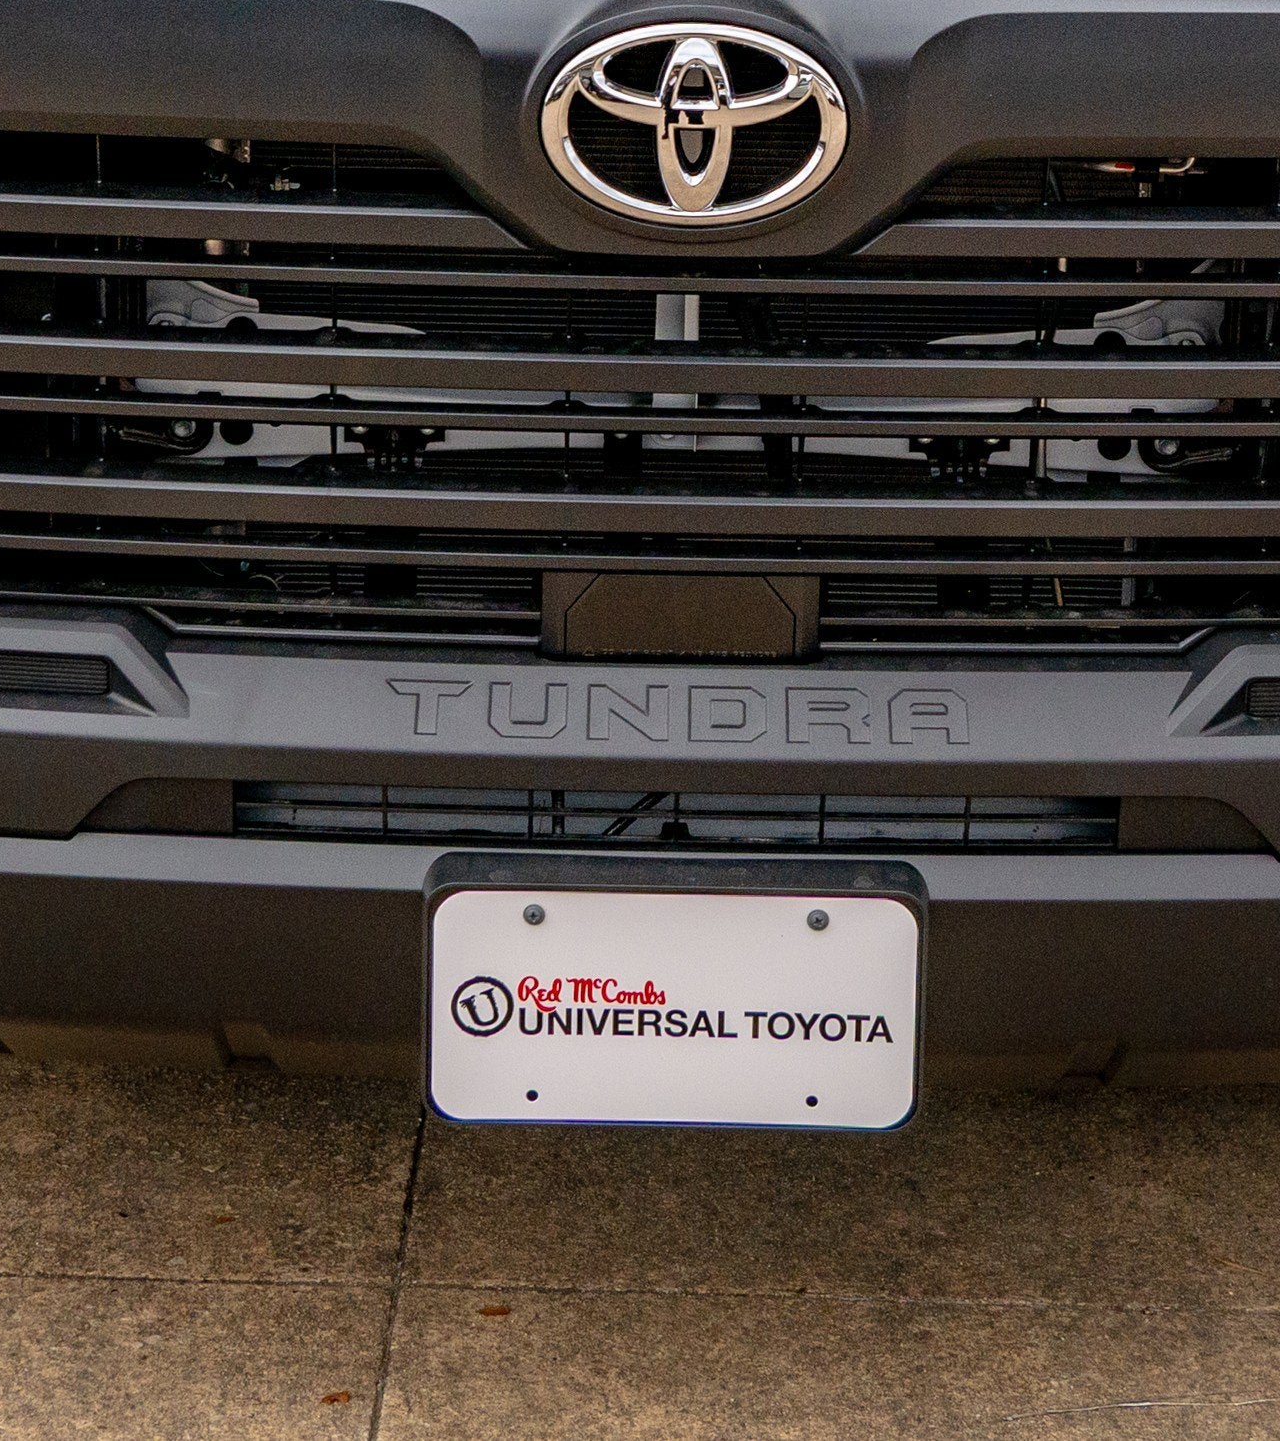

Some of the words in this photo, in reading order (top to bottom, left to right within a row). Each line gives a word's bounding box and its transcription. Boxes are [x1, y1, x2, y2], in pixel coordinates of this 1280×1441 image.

[385, 678, 970, 745] TUNDRA
[518, 976, 562, 1013] Red
[519, 1008, 738, 1039] UNIVERSAL
[745, 1011, 893, 1043] TOYOTA
